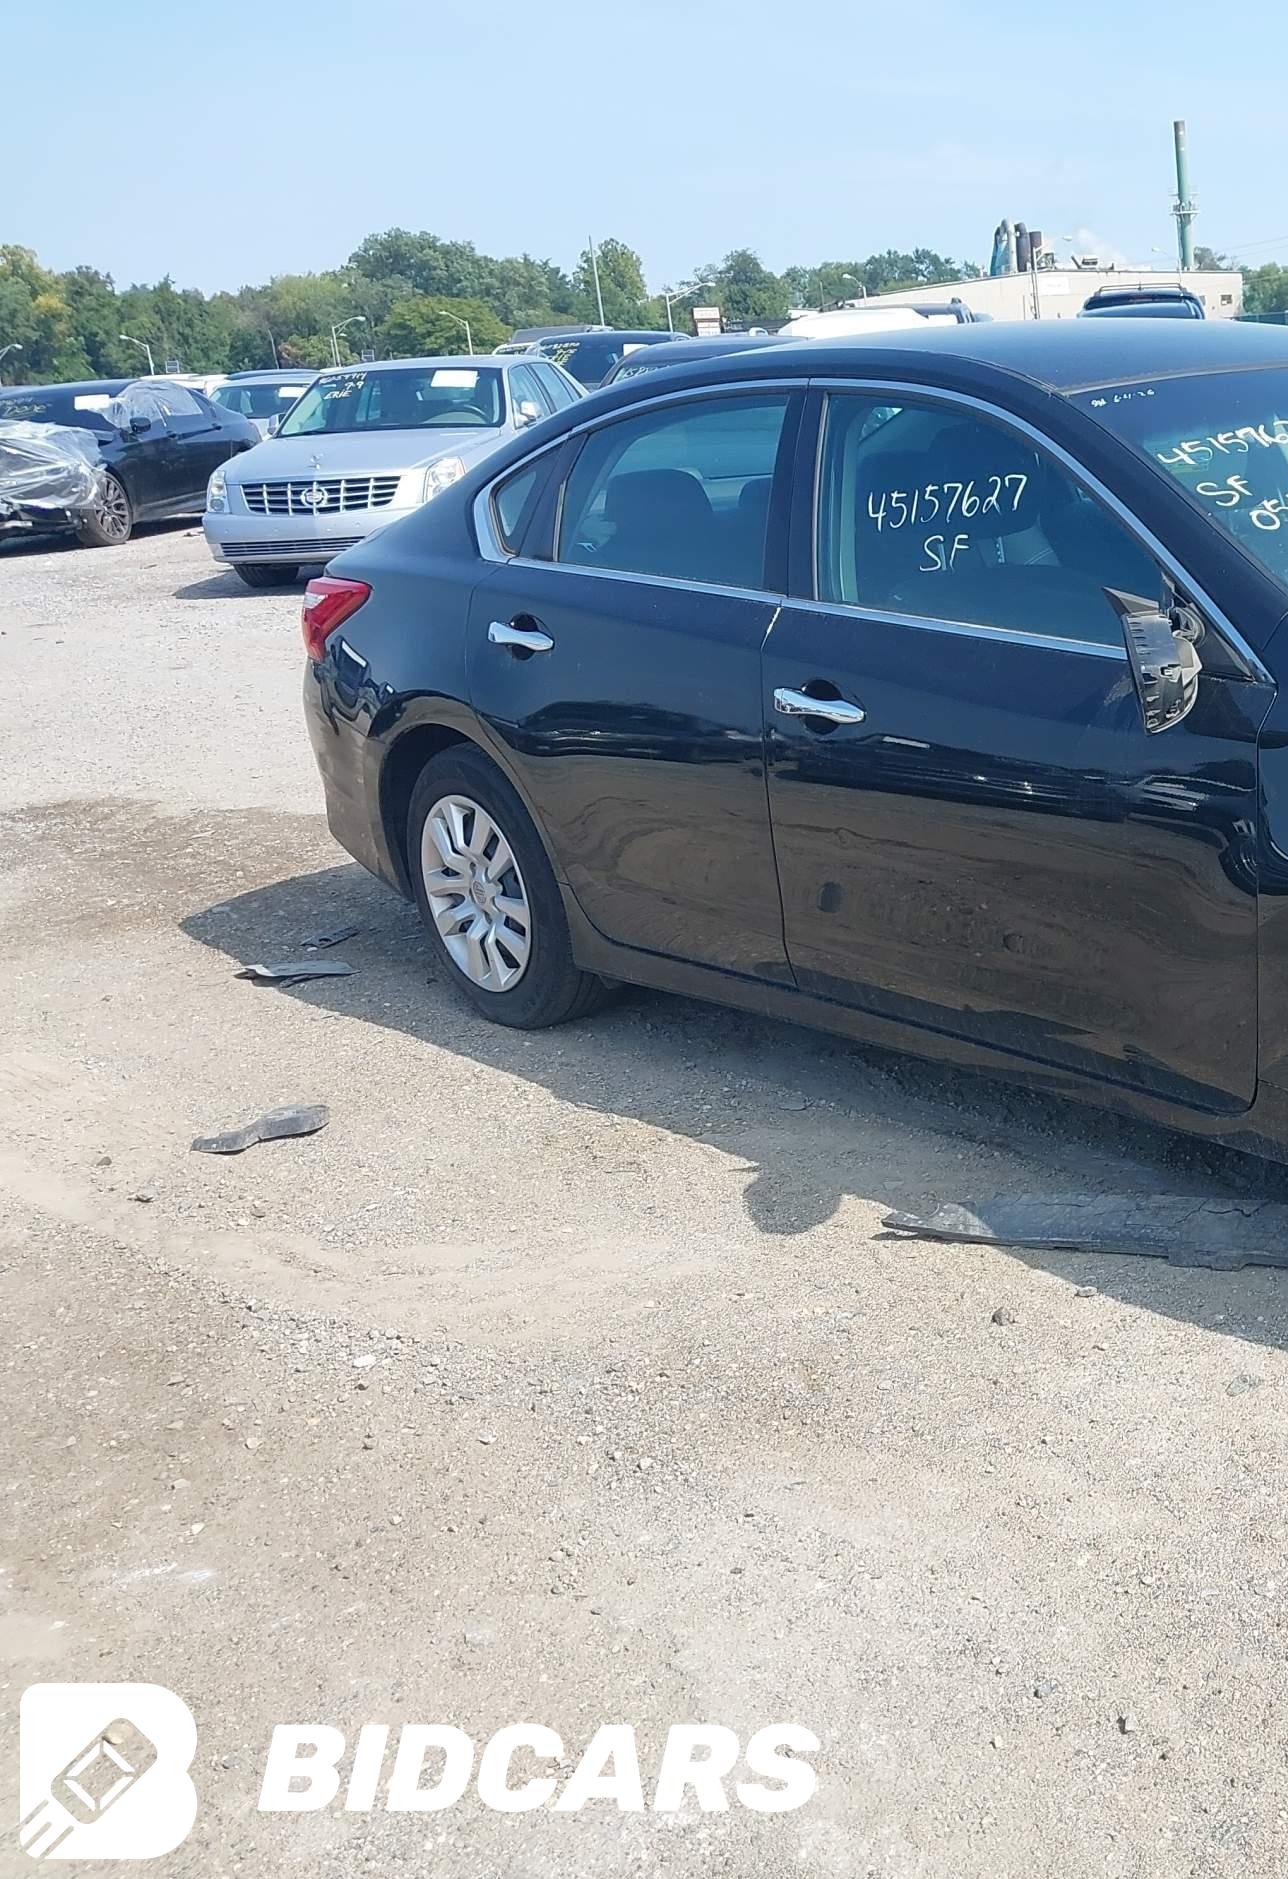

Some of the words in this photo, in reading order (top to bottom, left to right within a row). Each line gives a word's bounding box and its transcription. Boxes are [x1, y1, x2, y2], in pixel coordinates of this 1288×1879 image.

[868, 474, 1027, 532] 45157627
[1196, 475, 1253, 507] SF
[919, 534, 970, 573] SF
